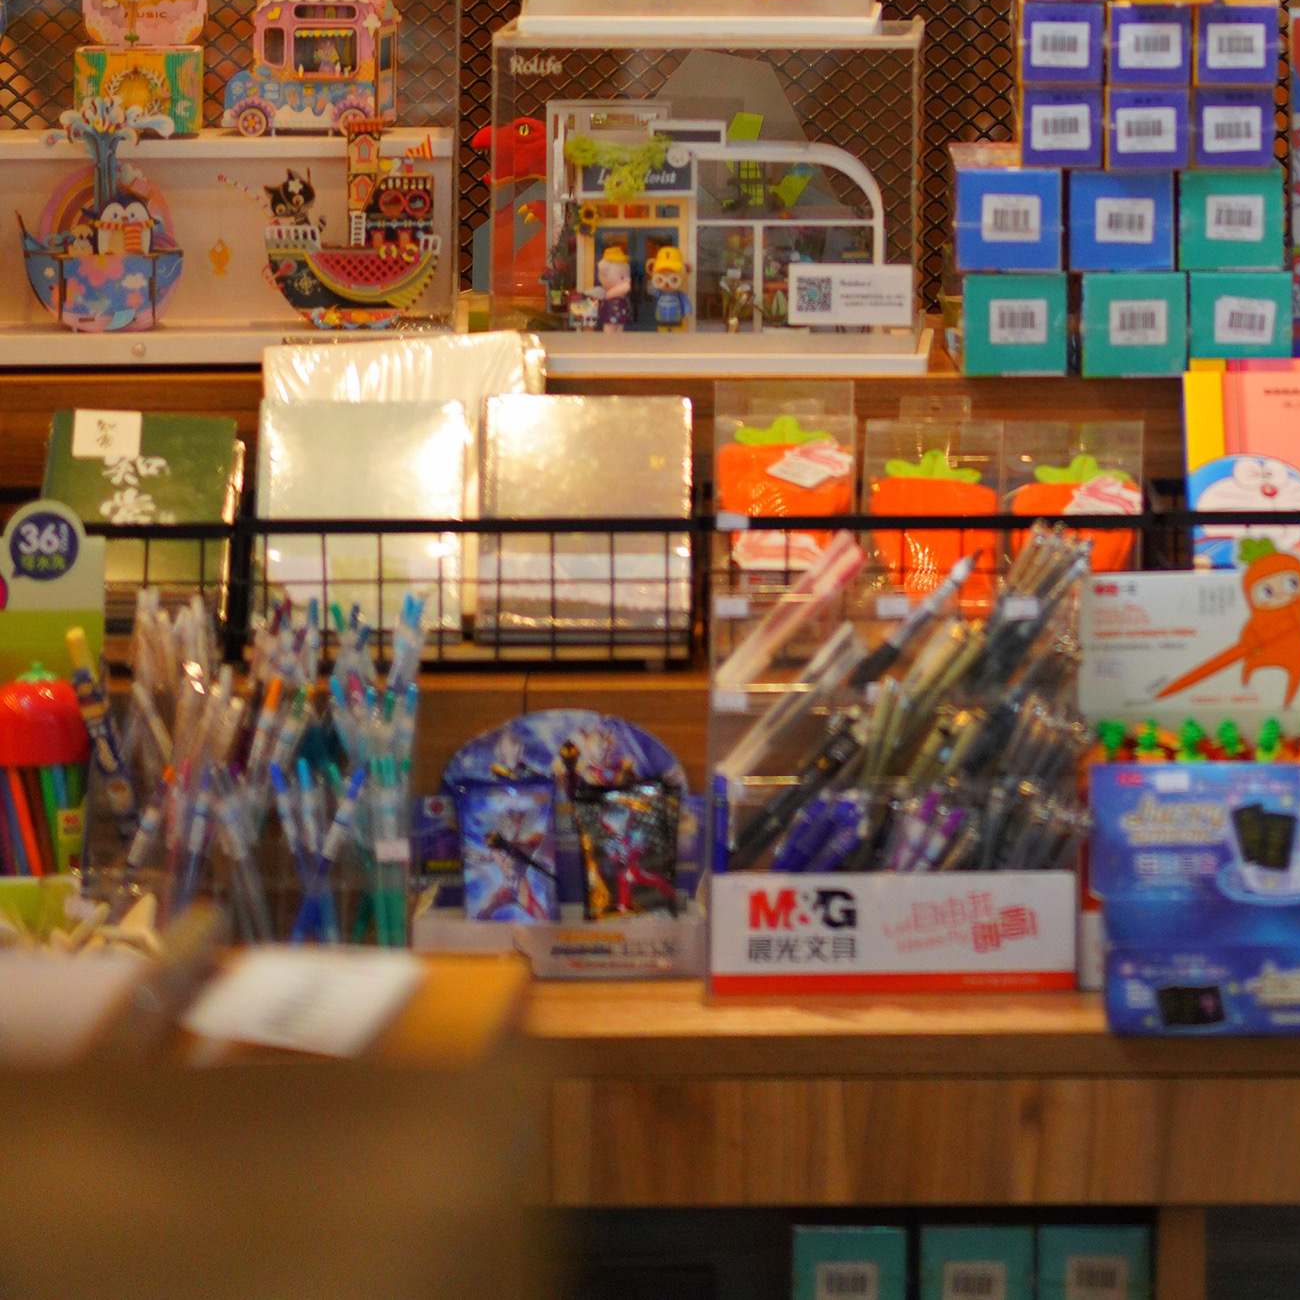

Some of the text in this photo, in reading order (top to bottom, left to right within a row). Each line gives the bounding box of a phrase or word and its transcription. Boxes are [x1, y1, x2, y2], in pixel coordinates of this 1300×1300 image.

[511, 55, 563, 76] Rolife
[18, 522, 60, 554] 36
[748, 889, 858, 931] M&G
